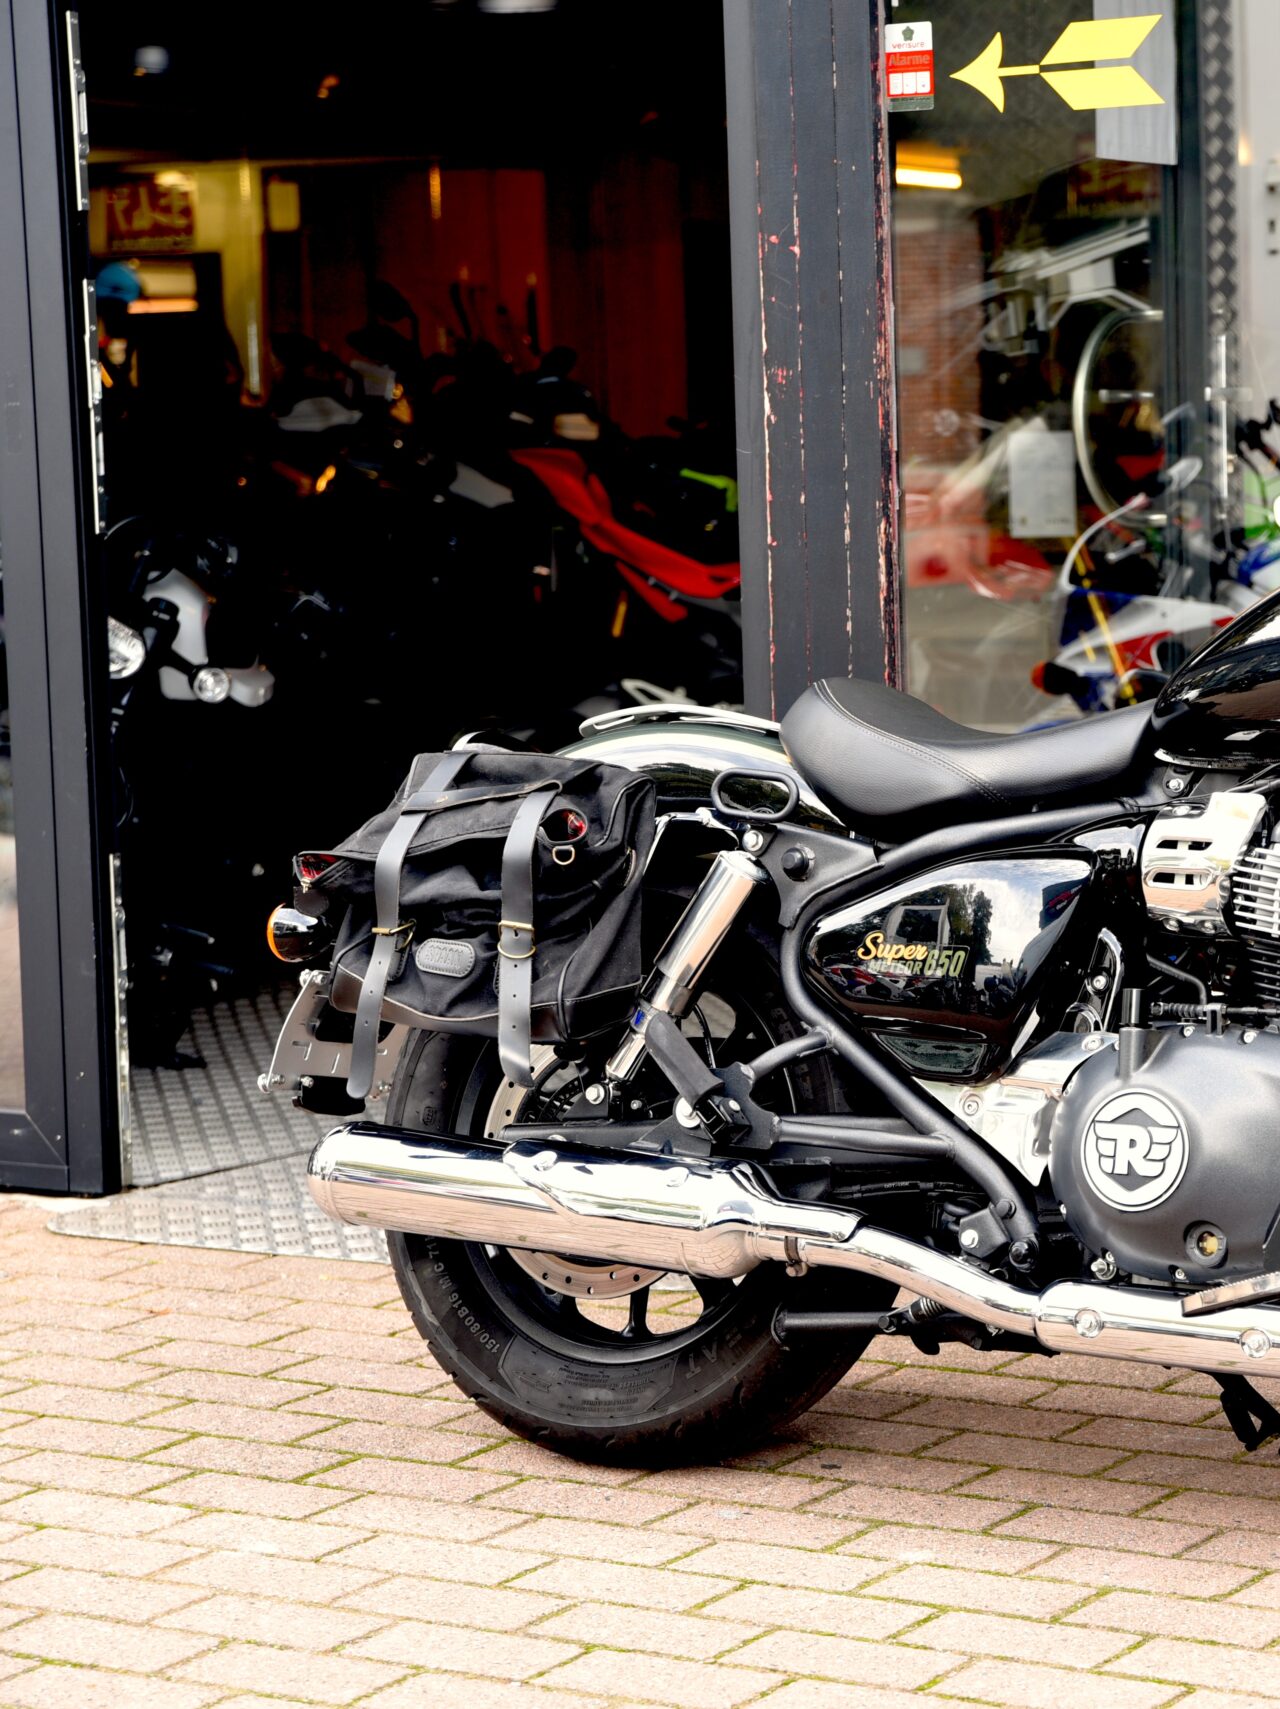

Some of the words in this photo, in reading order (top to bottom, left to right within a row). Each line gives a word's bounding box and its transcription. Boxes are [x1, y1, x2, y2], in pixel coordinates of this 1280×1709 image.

[888, 53, 930, 66] Alarme
[891, 41, 925, 50] verisure
[857, 930, 928, 965] Super
[924, 950, 966, 977] 650
[448, 1292, 500, 1353] 150/80B16
